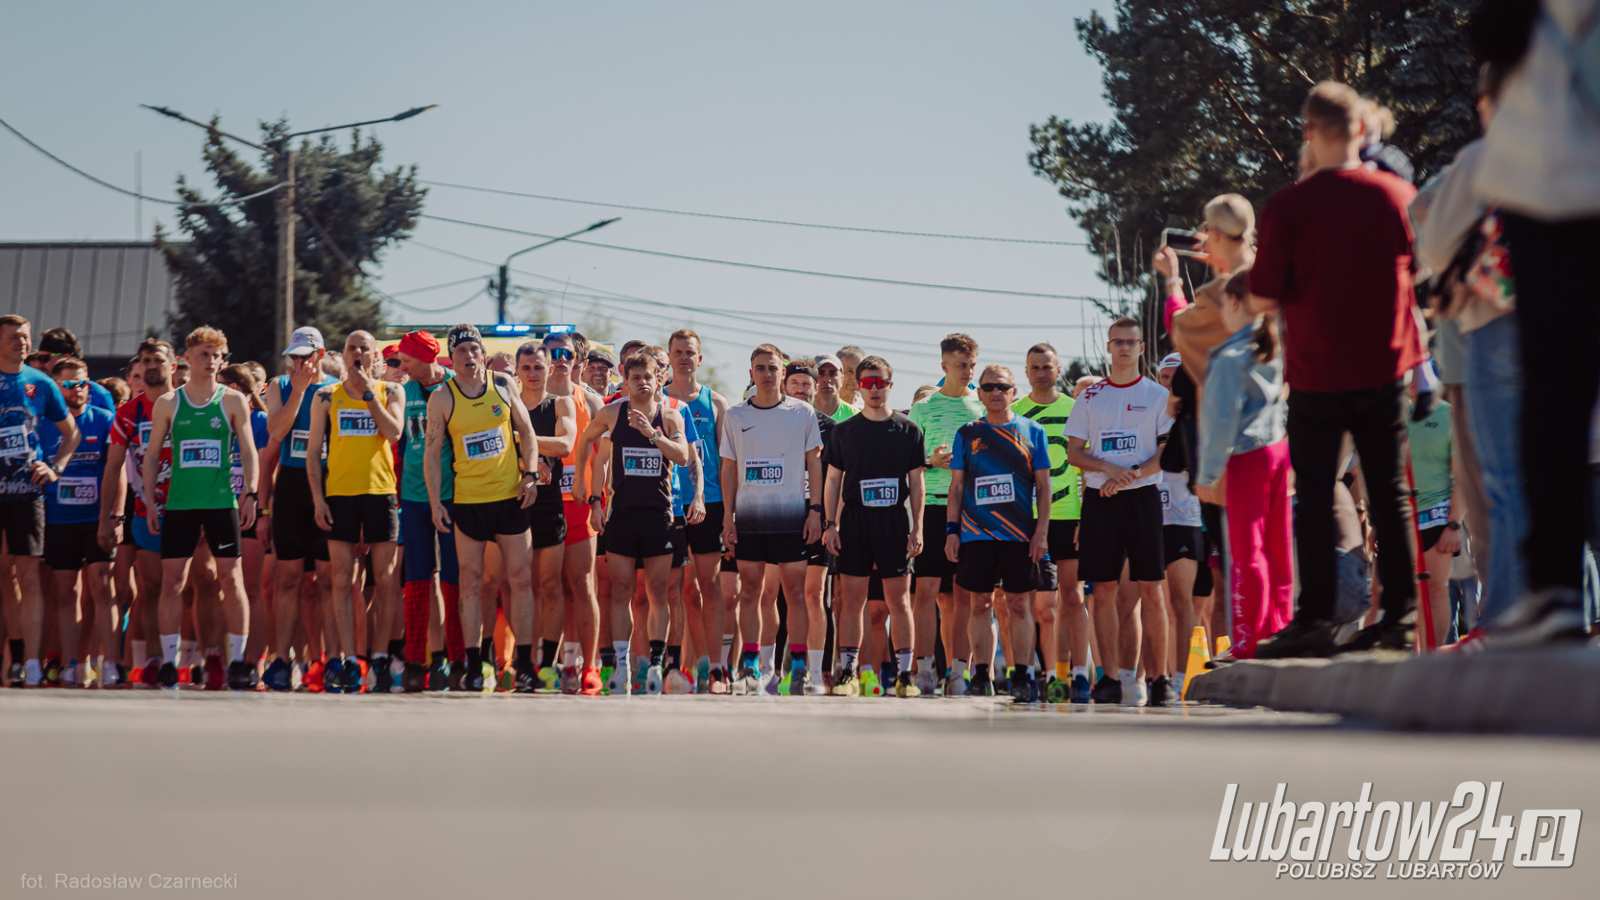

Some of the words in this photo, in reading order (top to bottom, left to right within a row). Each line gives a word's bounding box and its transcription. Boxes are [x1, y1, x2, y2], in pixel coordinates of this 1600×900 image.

[357, 418, 376, 430] 115
[483, 436, 503, 452] 095
[1116, 436, 1136, 449] 070
[640, 457, 660, 470] 139
[761, 467, 781, 479] 080
[879, 487, 896, 499] 161
[990, 483, 1011, 496] 048
